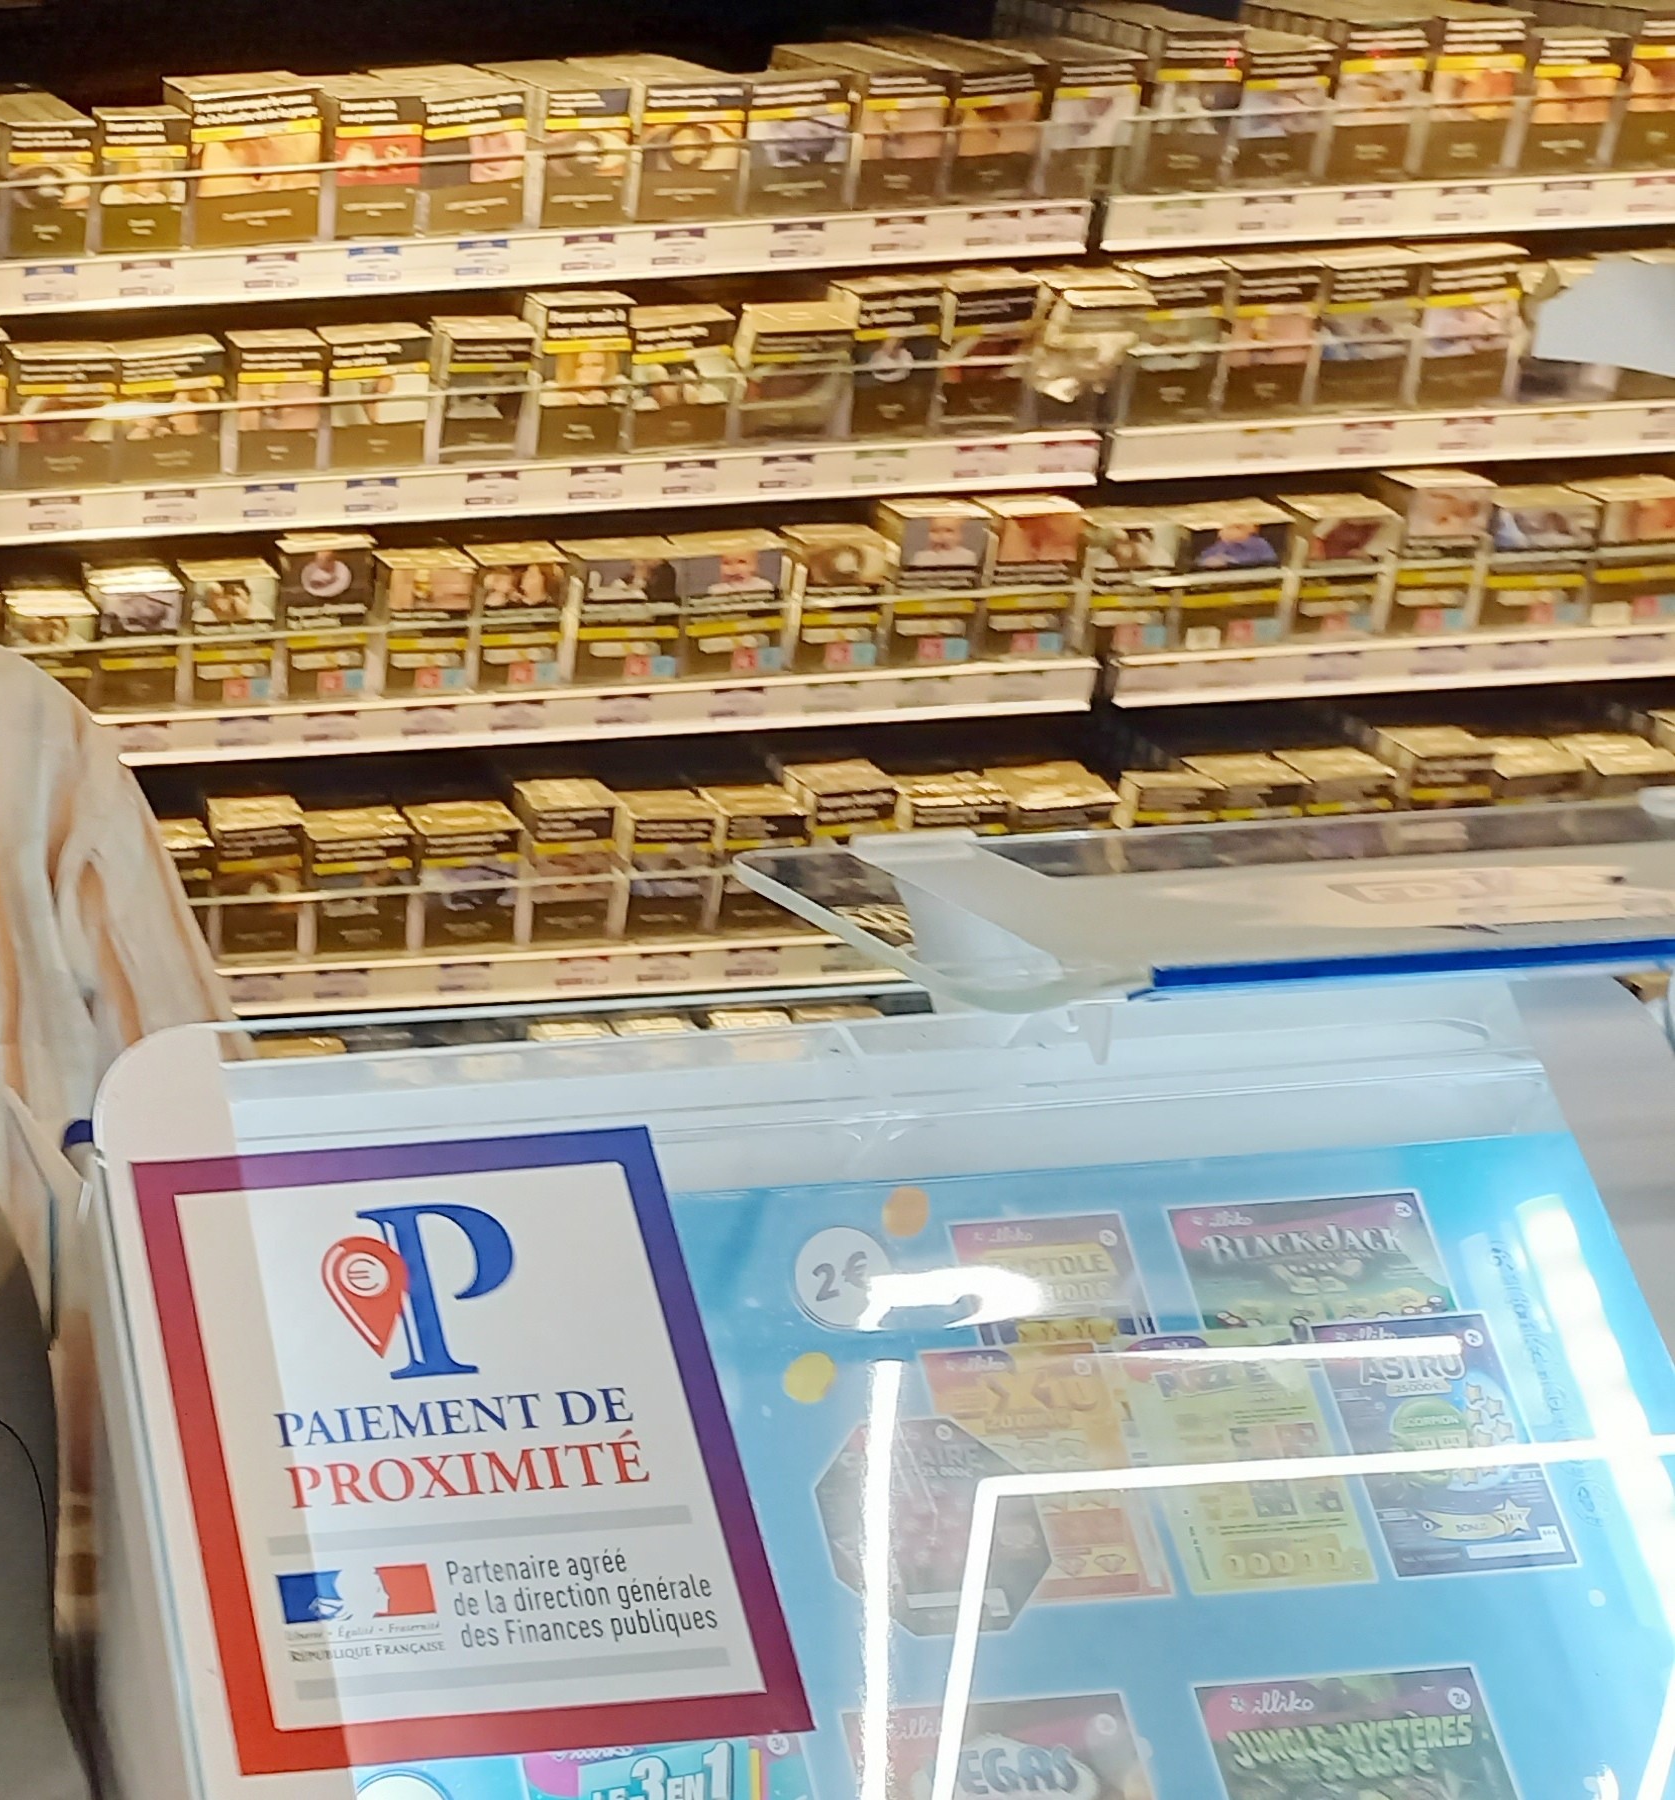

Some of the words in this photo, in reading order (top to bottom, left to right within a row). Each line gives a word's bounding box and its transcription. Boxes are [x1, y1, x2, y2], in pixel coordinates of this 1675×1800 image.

[273, 1393, 540, 1448] PAIEMENT
[555, 1387, 634, 1427] DE
[284, 1429, 650, 1509] PROXIMITÉ
[446, 1555, 560, 1586] Partenaire
[567, 1548, 628, 1581] agréé
[454, 1592, 480, 1616] de
[485, 1589, 507, 1614] la
[514, 1582, 611, 1612] direction
[618, 1573, 713, 1610] générale
[461, 1622, 499, 1648] des
[506, 1618, 604, 1645] Finances
[611, 1607, 719, 1642] publiques
[1252, 1689, 1315, 1714] illiko
[1336, 1710, 1474, 1755] MYSTÈRES
